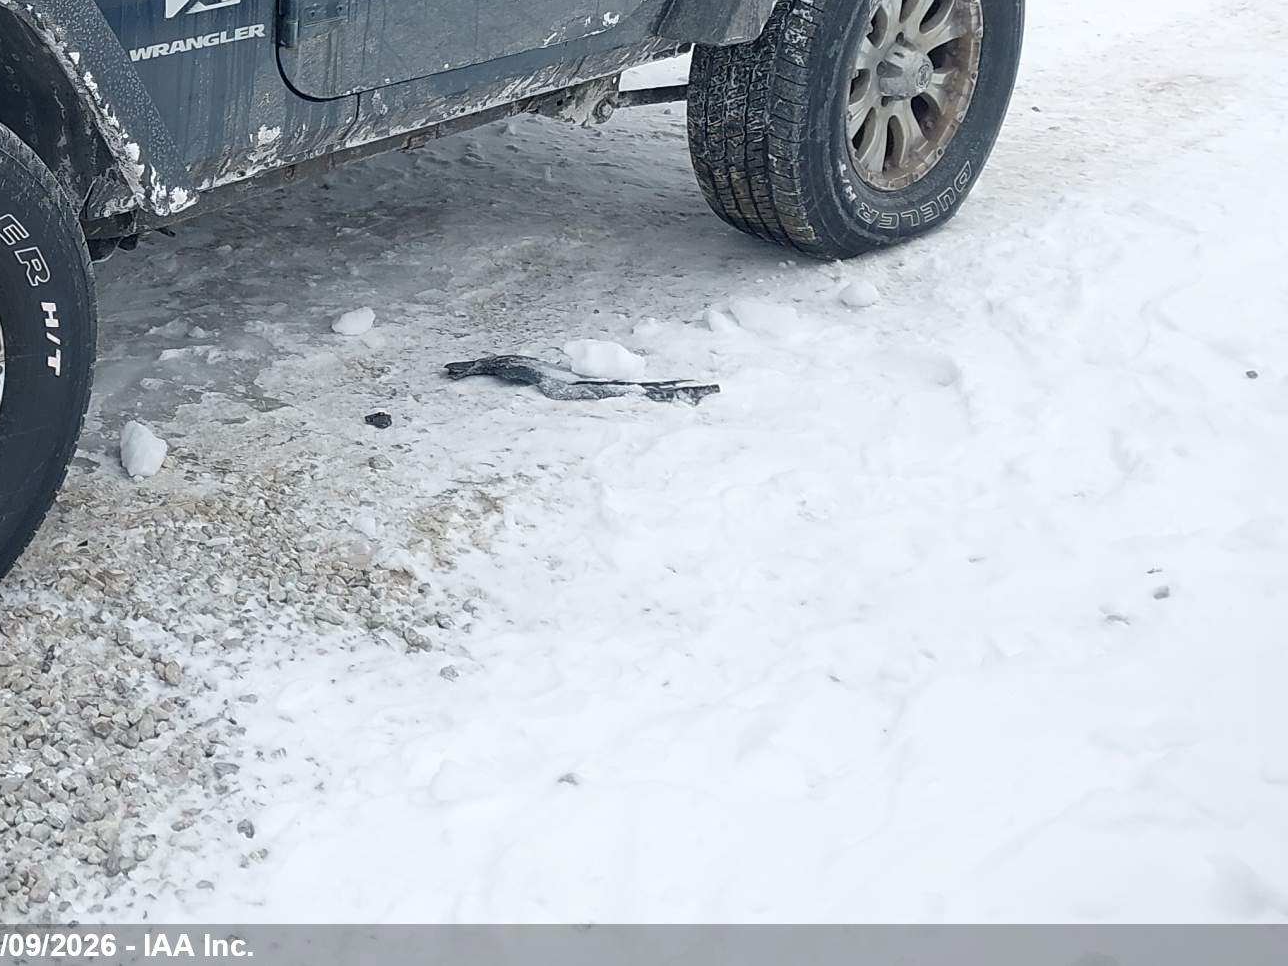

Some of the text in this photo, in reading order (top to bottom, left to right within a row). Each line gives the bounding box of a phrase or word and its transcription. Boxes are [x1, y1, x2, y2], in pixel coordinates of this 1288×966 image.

[129, 24, 265, 62] WRANGLER
[857, 160, 972, 229] DUELER
[40, 301, 62, 377] H/T
